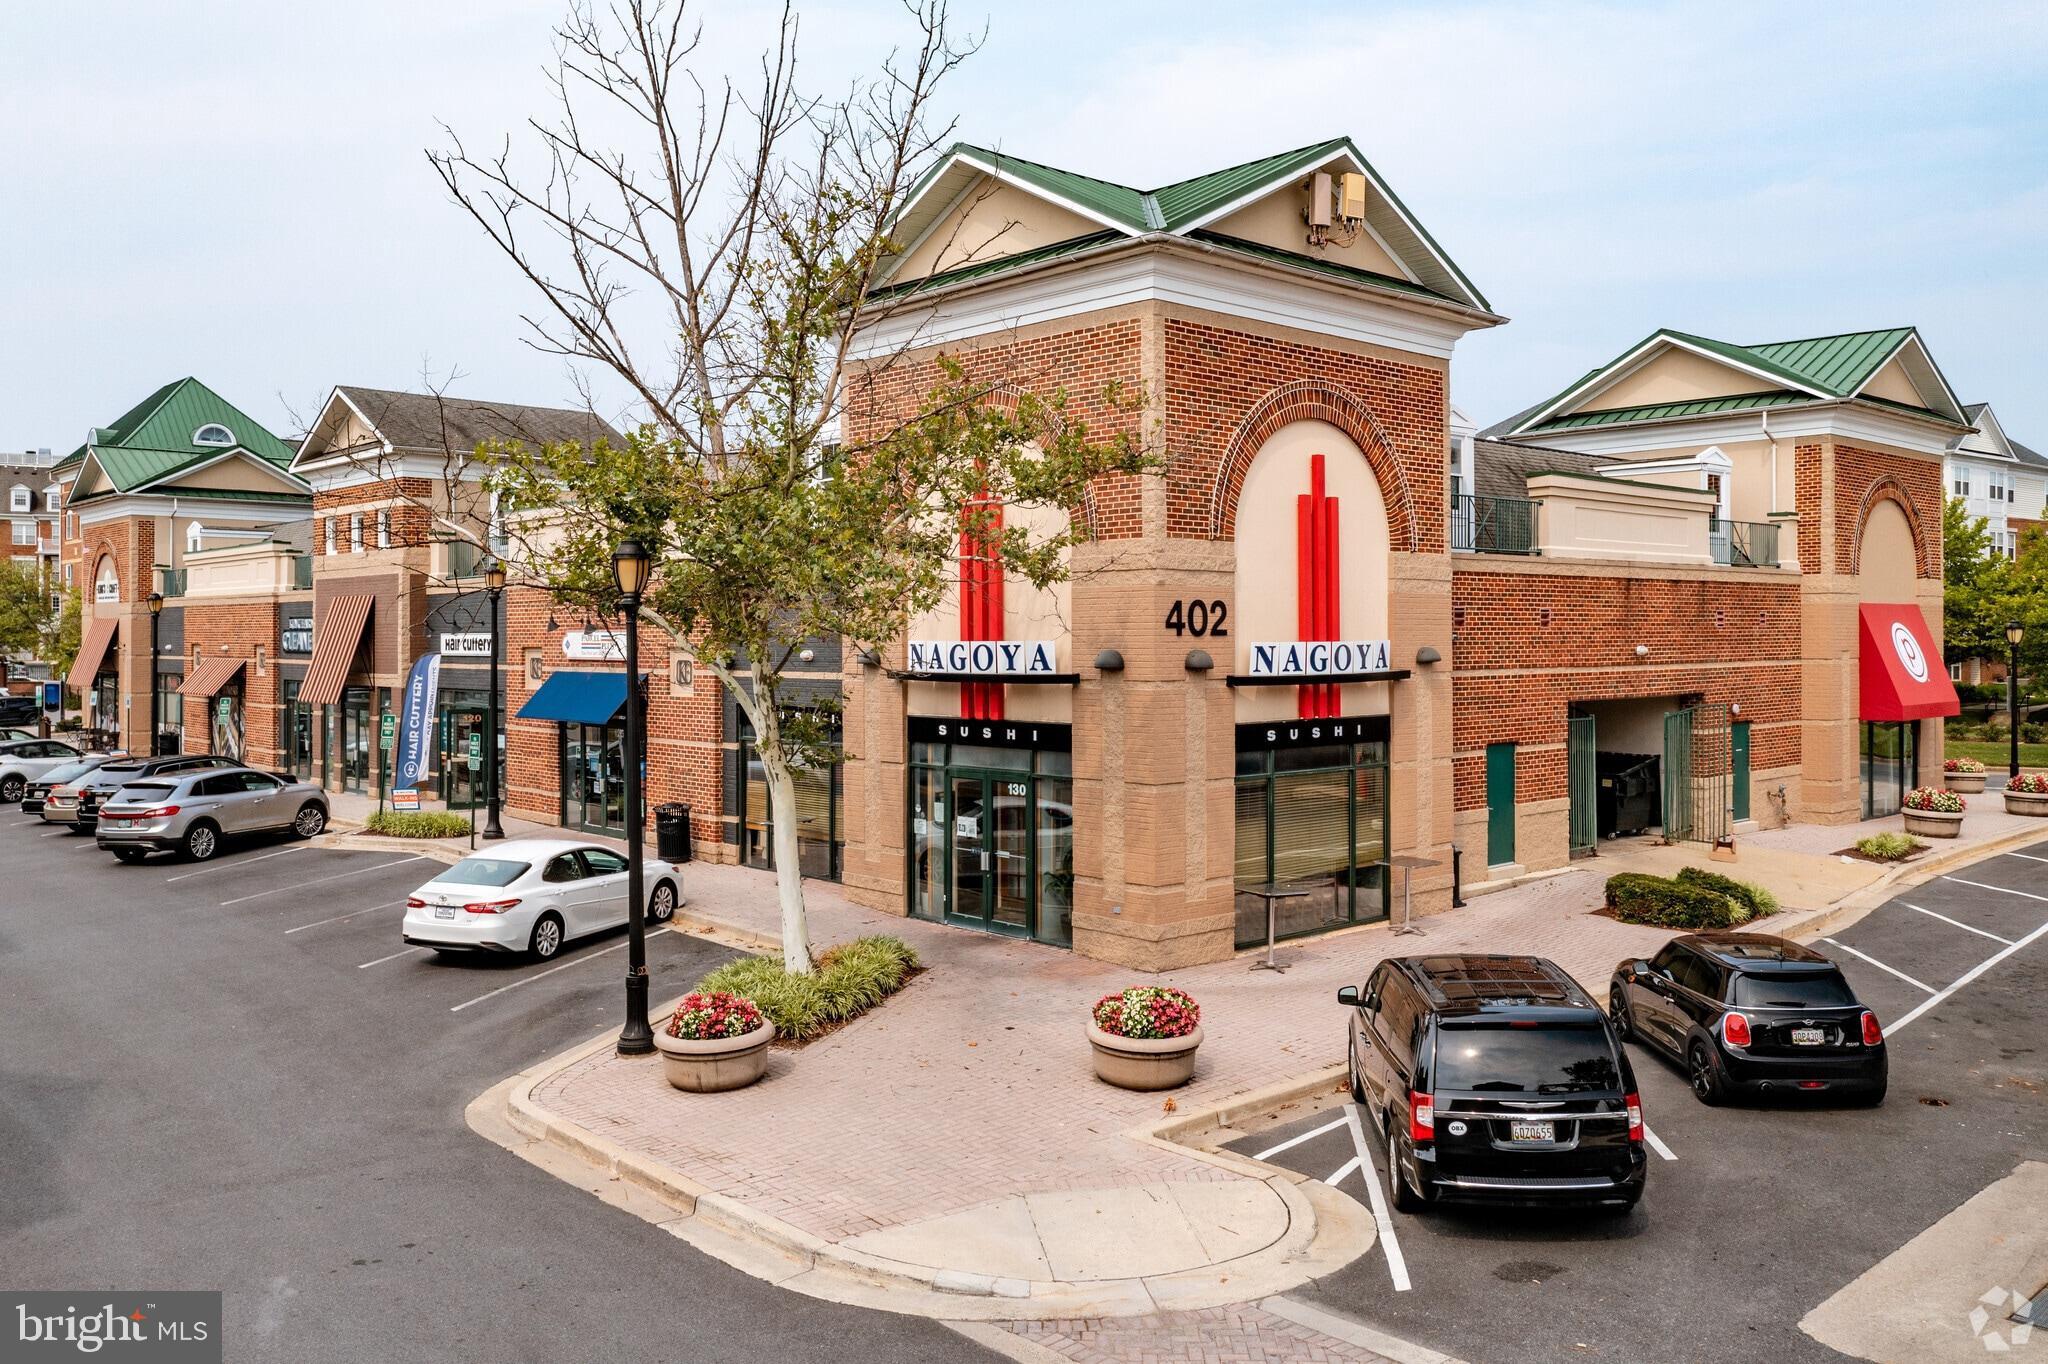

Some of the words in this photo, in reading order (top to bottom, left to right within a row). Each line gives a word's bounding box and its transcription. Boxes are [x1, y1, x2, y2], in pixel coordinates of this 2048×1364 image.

[1165, 599, 1228, 637] 402
[910, 643, 1053, 672] NAGOYA
[1252, 643, 1389, 673] NAGOYA
[410, 674, 423, 728] CUTTERY
[408, 730, 419, 760] HAIR
[938, 724, 1038, 742] SUSHI
[1266, 723, 1362, 742] SUSHI
[1007, 783, 1027, 796] 130
